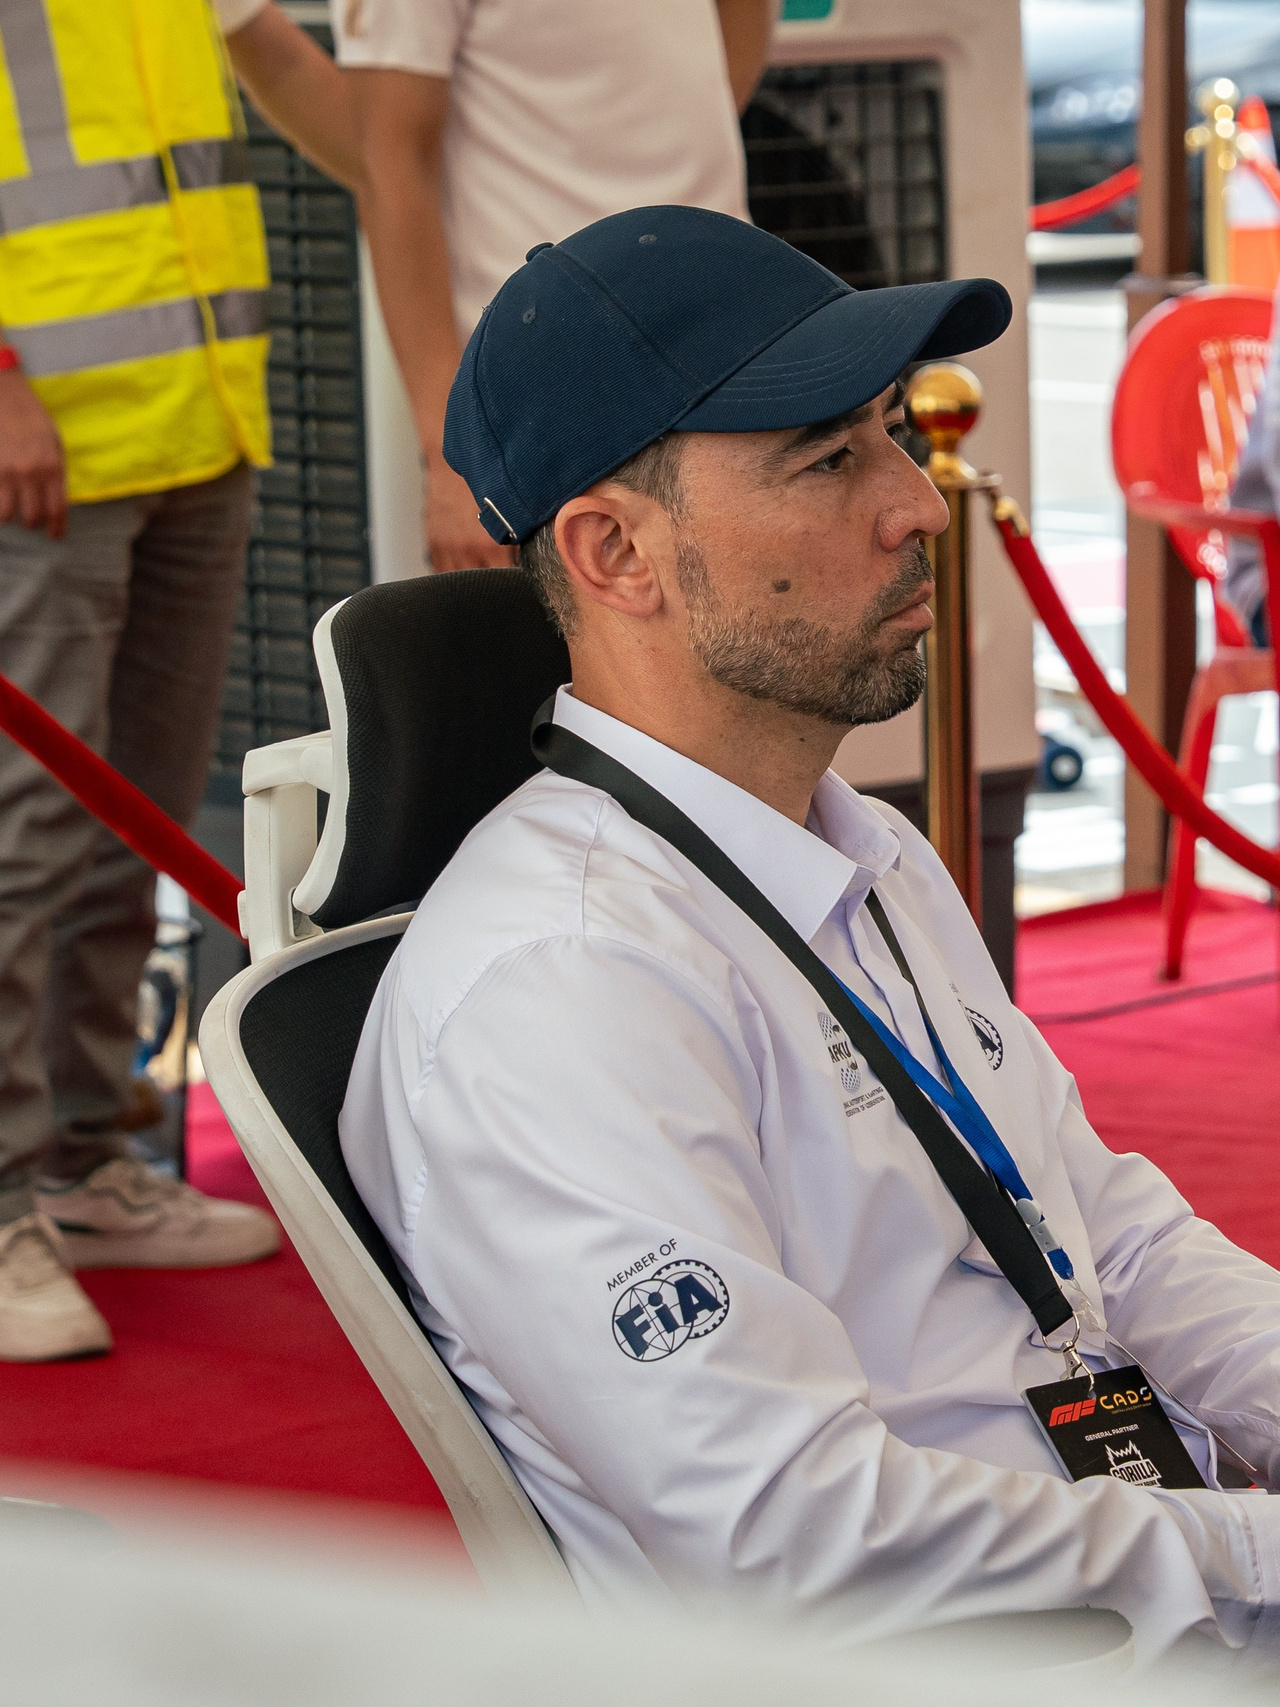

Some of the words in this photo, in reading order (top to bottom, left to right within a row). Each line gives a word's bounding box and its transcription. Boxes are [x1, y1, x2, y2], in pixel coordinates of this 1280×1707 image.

[828, 1041, 852, 1063] AFKU
[607, 1252, 659, 1291] MEMBER
[659, 1238, 678, 1256] OF
[1085, 1431, 1112, 1441] GENERAL
[1112, 1424, 1140, 1435] PARTNER
[1112, 1461, 1159, 1483] GORILLA
